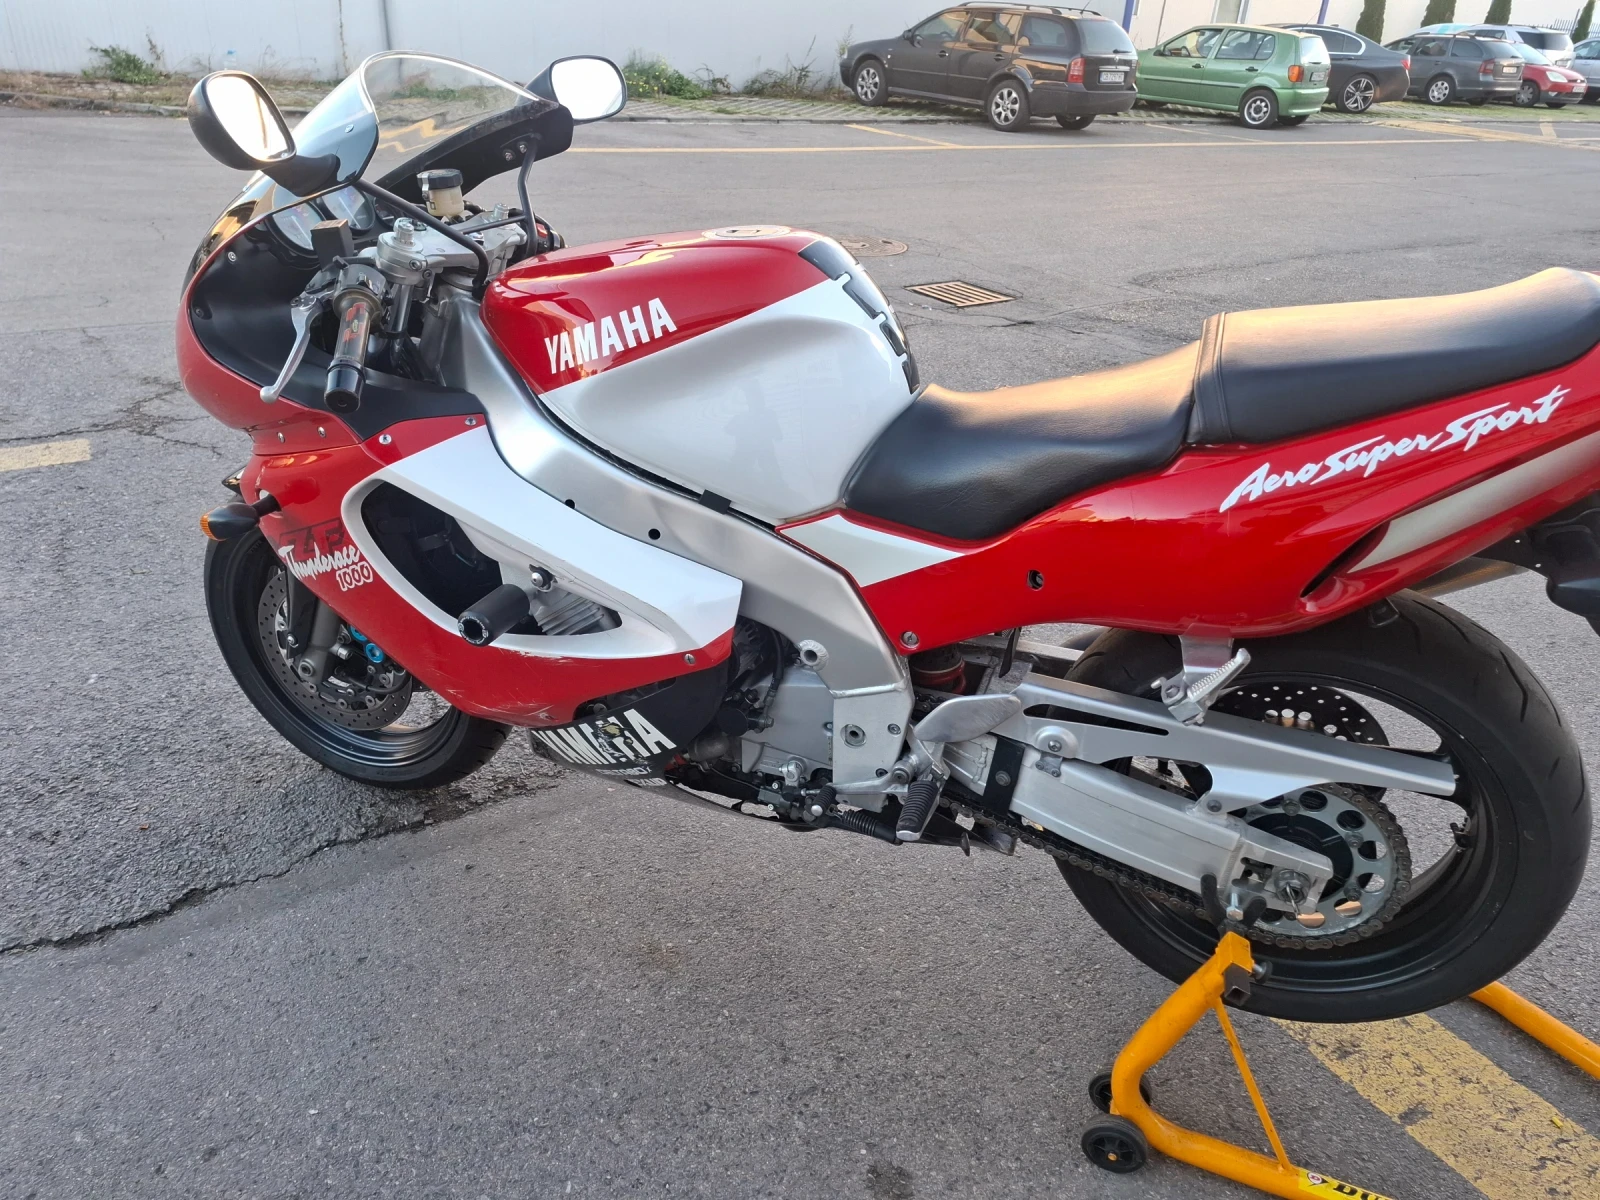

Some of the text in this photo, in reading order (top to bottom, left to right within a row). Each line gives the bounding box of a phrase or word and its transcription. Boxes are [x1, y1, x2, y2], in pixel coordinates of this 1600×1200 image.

[544, 298, 677, 374] YAMAHA
[278, 541, 360, 580] Thunderace
[336, 561, 373, 592] 1000
